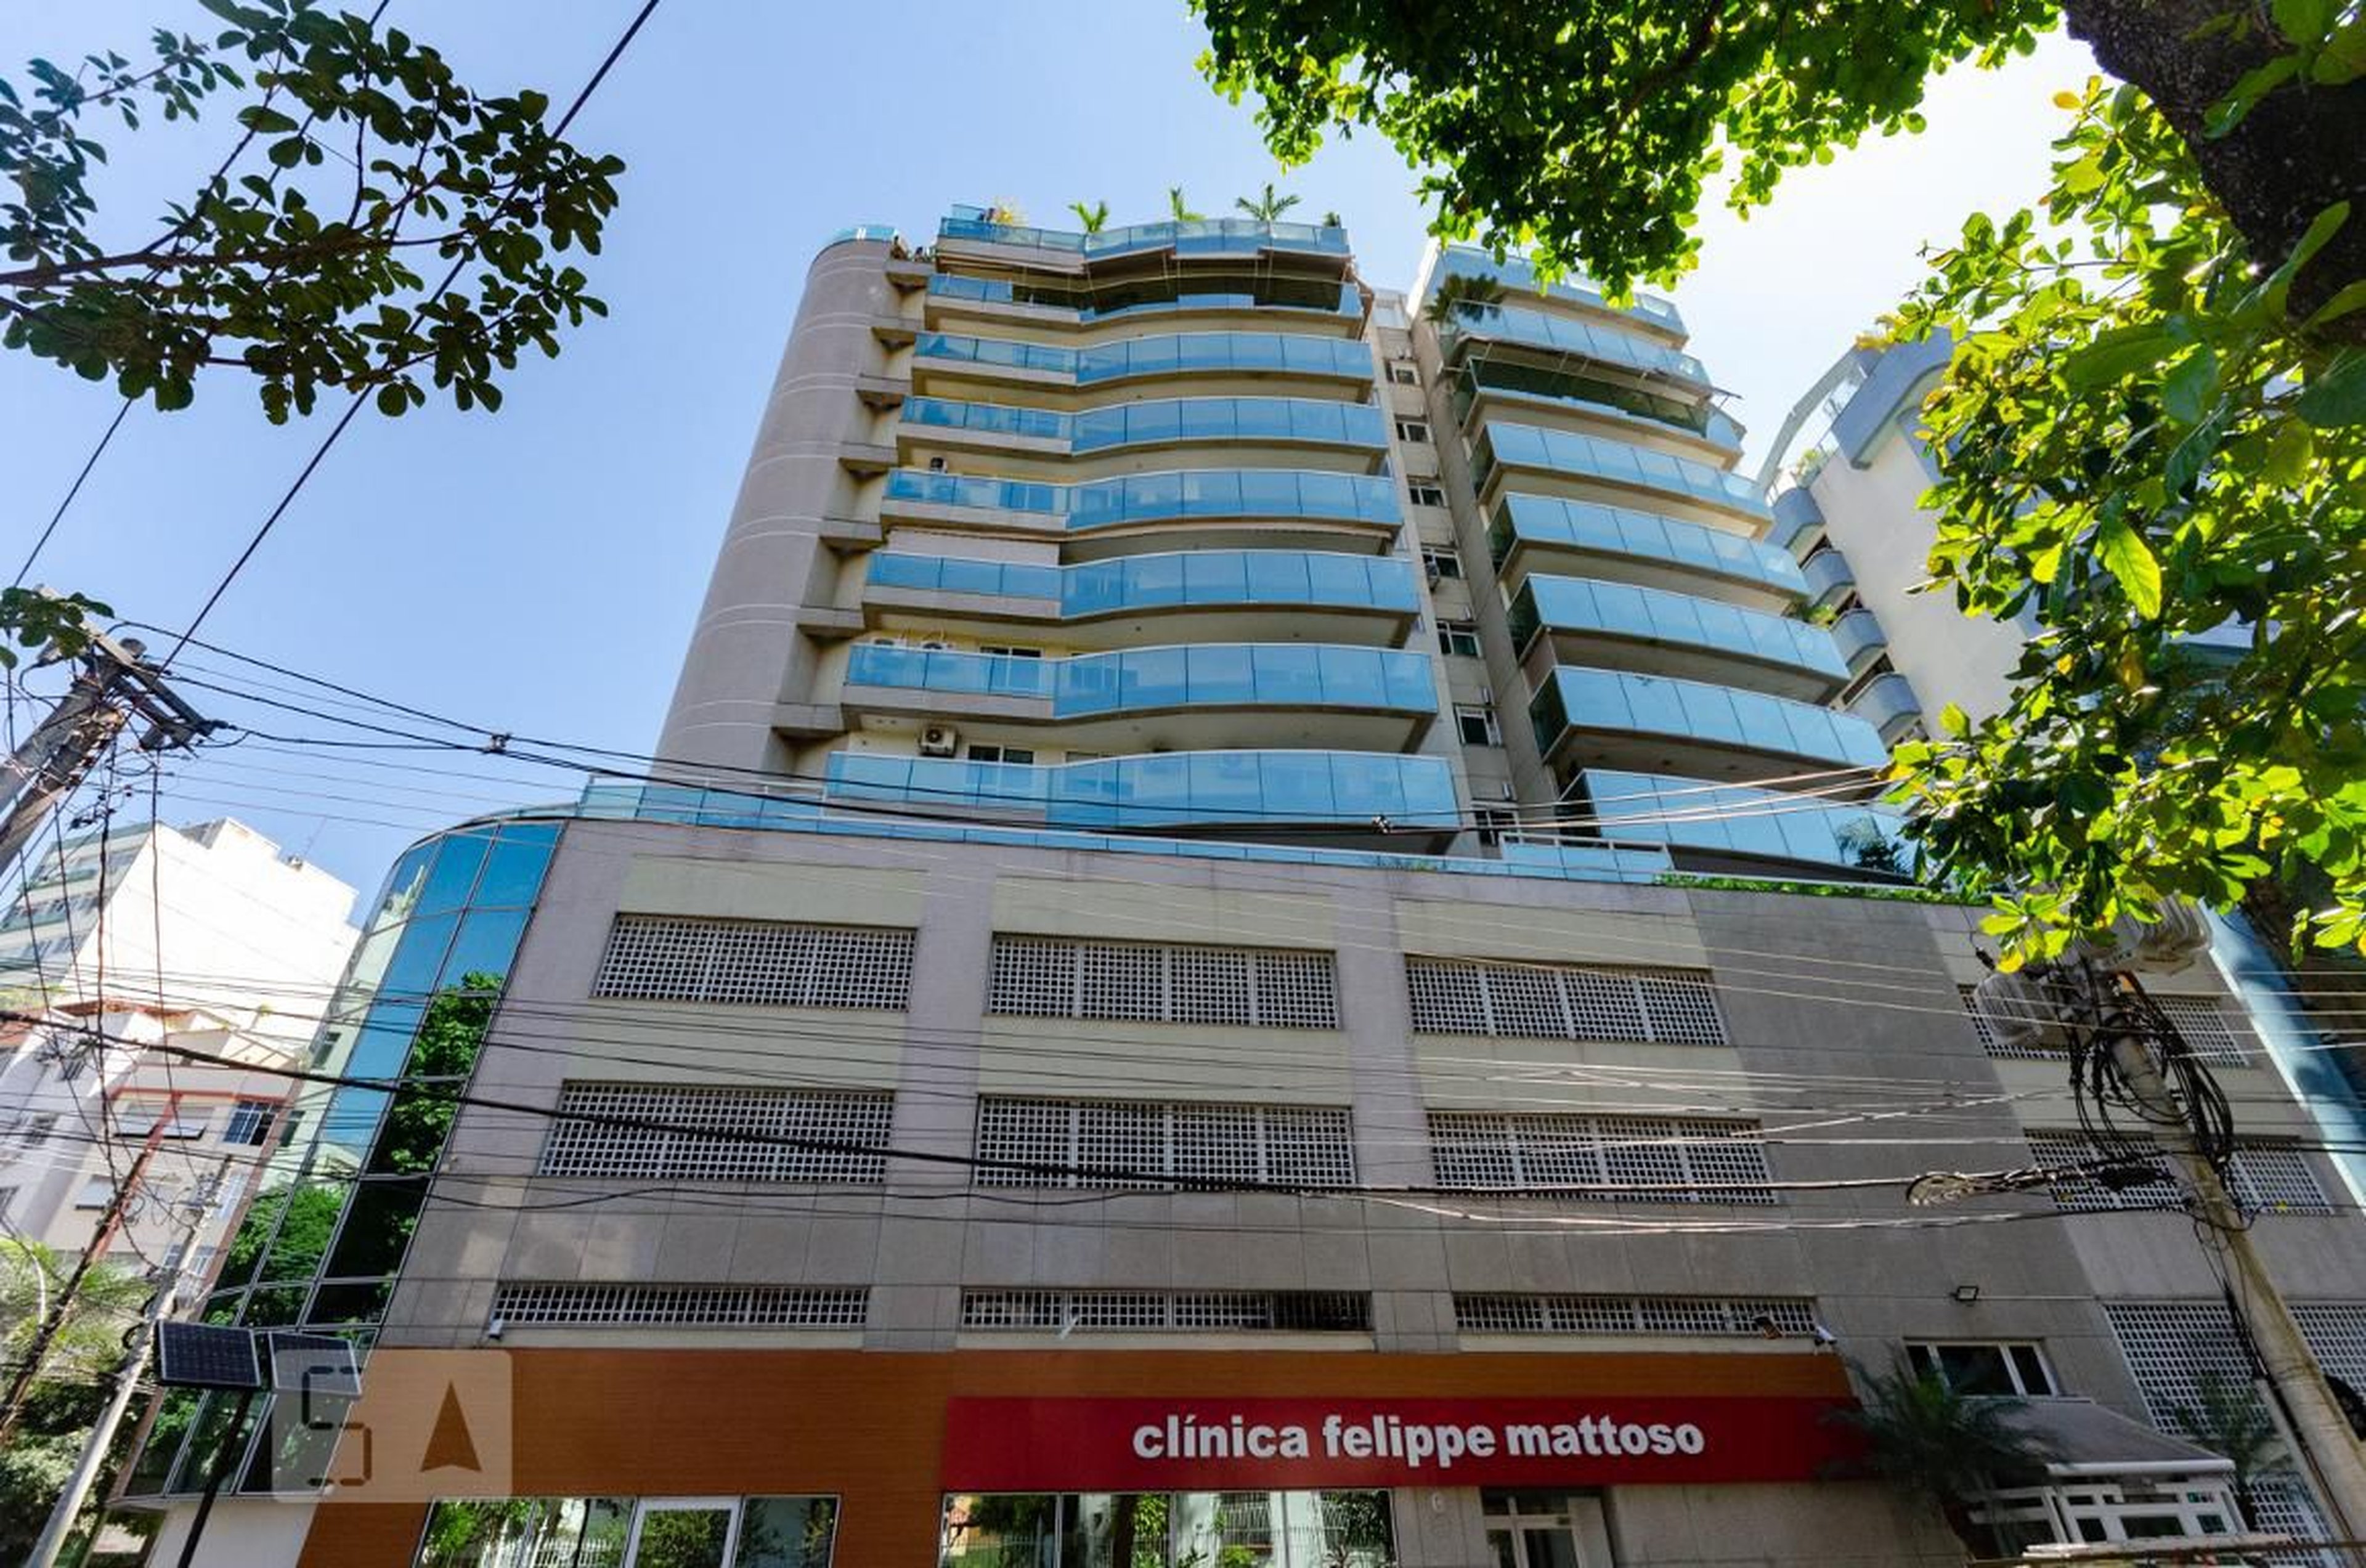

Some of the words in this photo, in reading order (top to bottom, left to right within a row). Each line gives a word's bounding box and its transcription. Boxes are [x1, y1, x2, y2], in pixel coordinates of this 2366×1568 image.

[1133, 1415, 1309, 1458] clínica
[1322, 1415, 1495, 1468] felippe
[1505, 1415, 1704, 1455] mattoso
